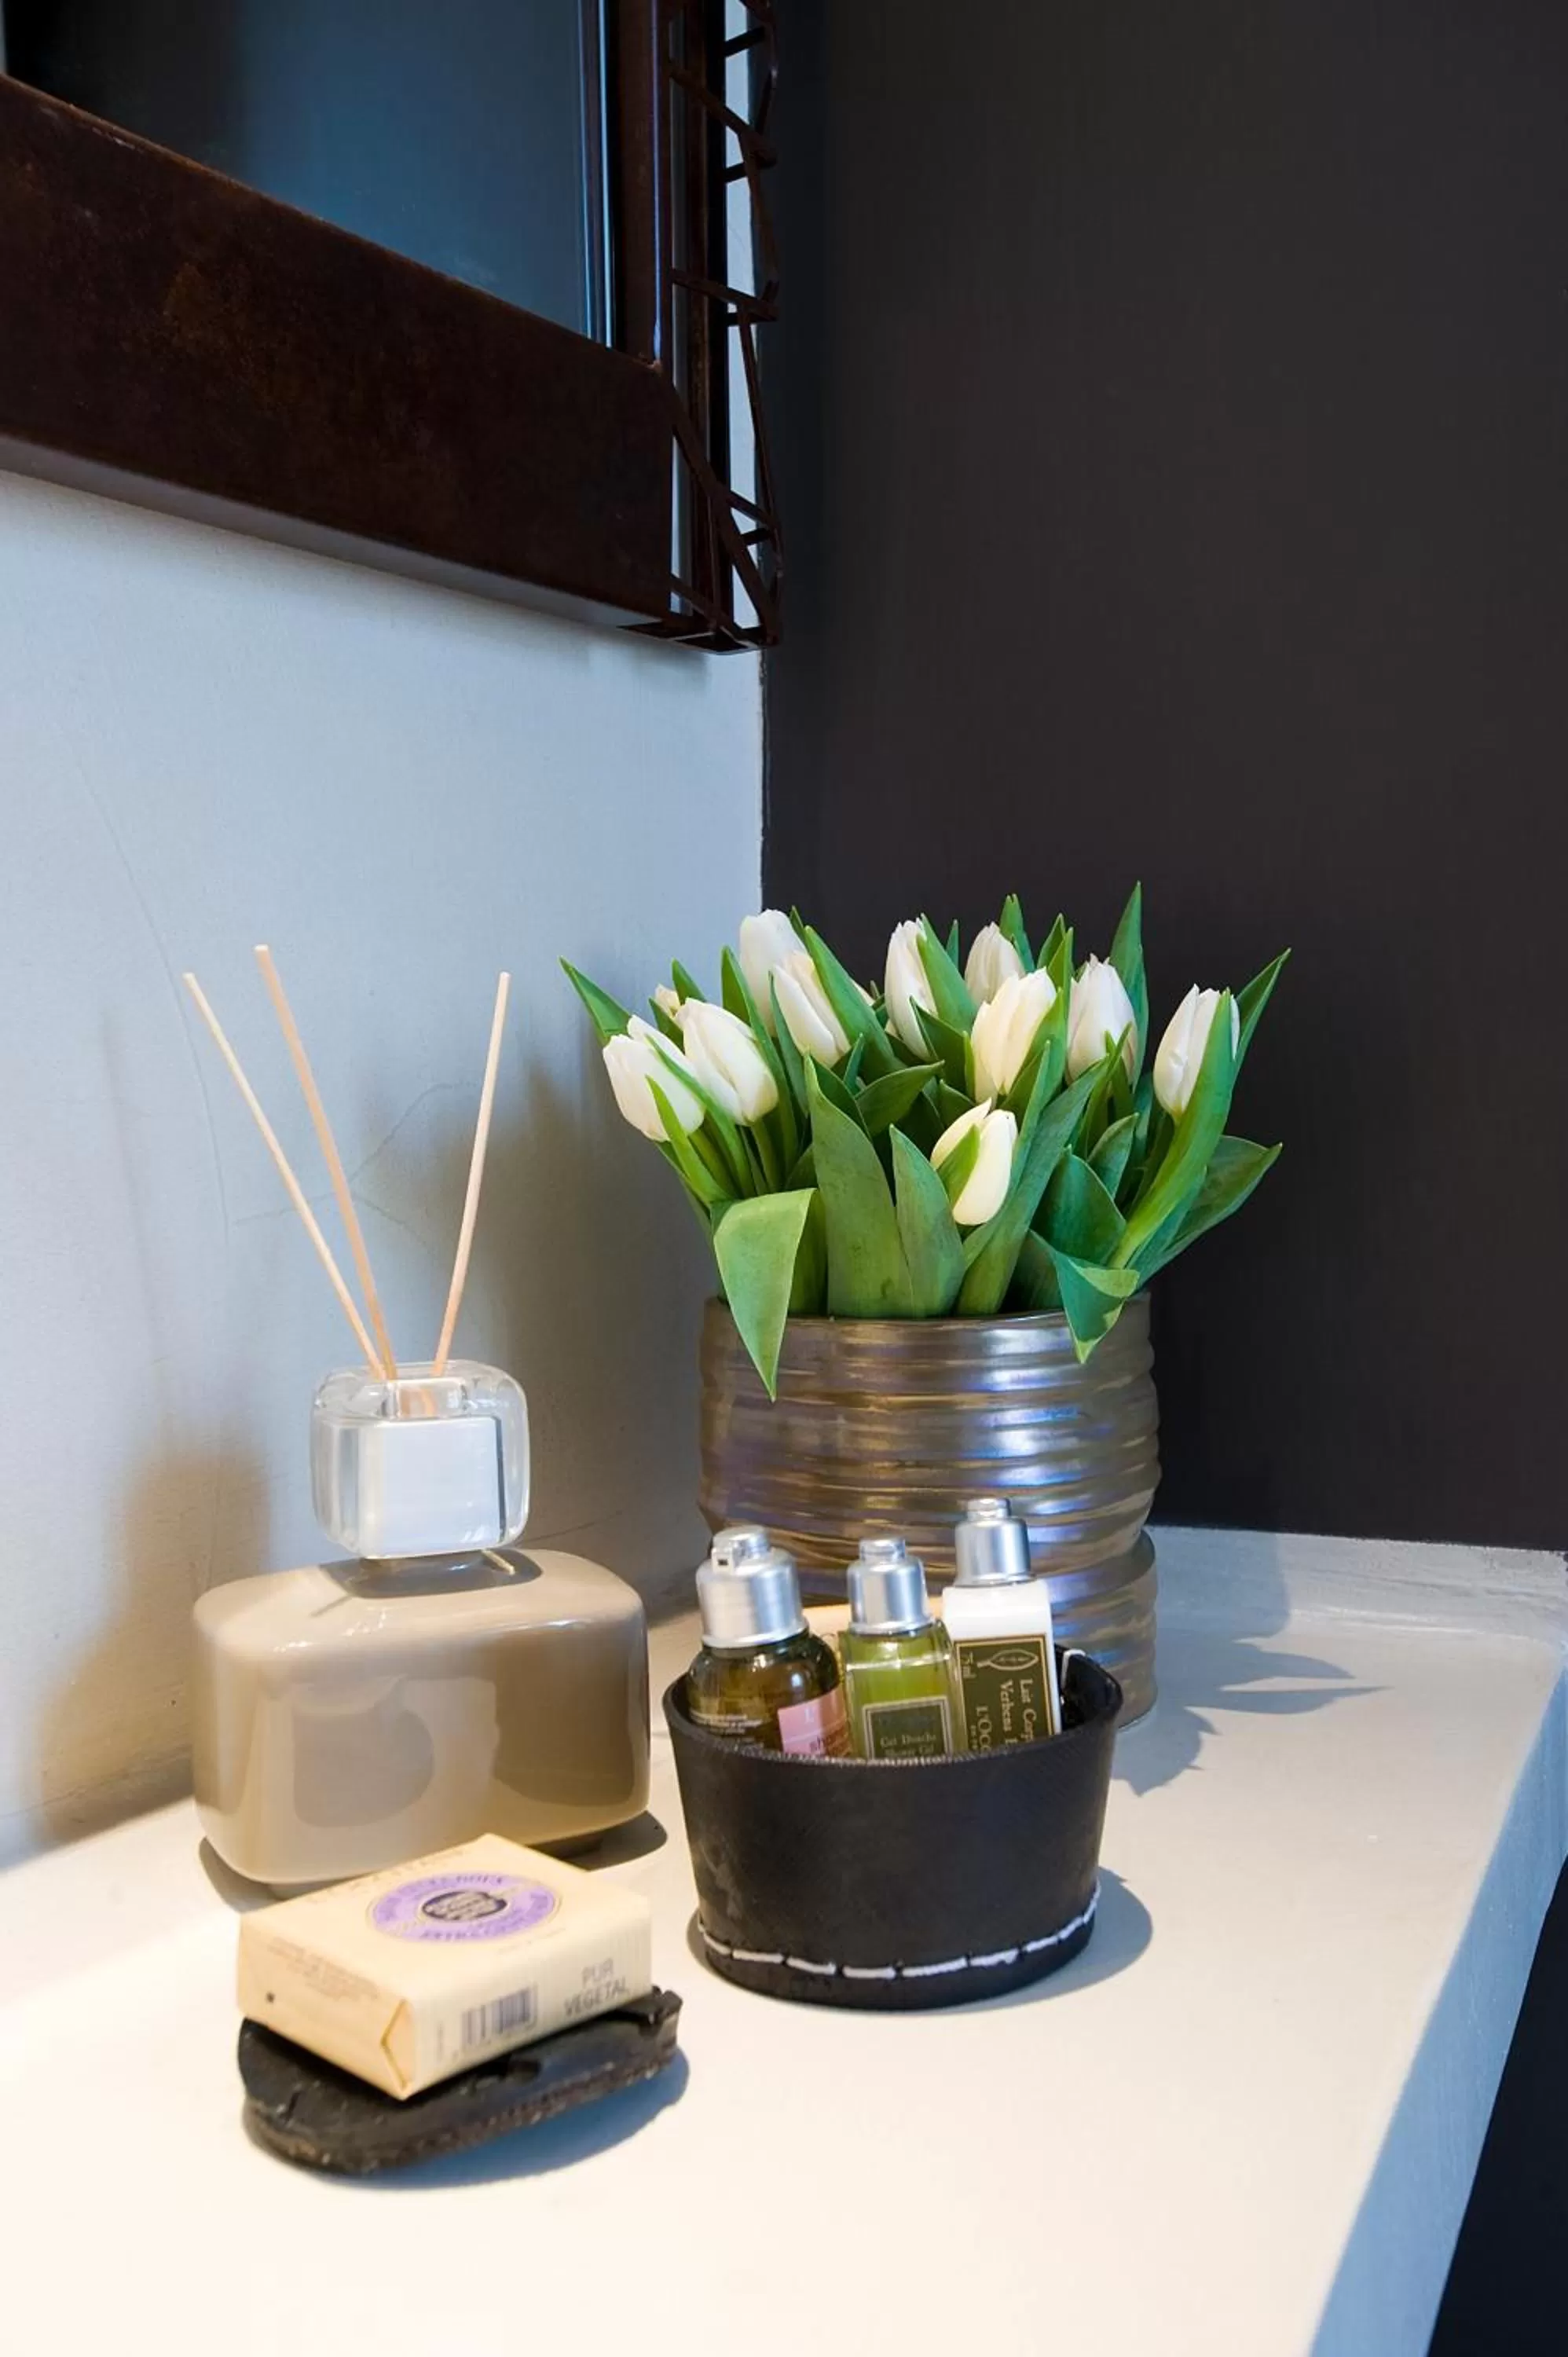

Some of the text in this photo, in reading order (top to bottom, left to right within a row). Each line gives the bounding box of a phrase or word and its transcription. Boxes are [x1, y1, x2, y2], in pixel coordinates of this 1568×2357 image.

[1020, 1678, 1038, 1743] Lait Corp
[581, 1958, 614, 1988] PUR
